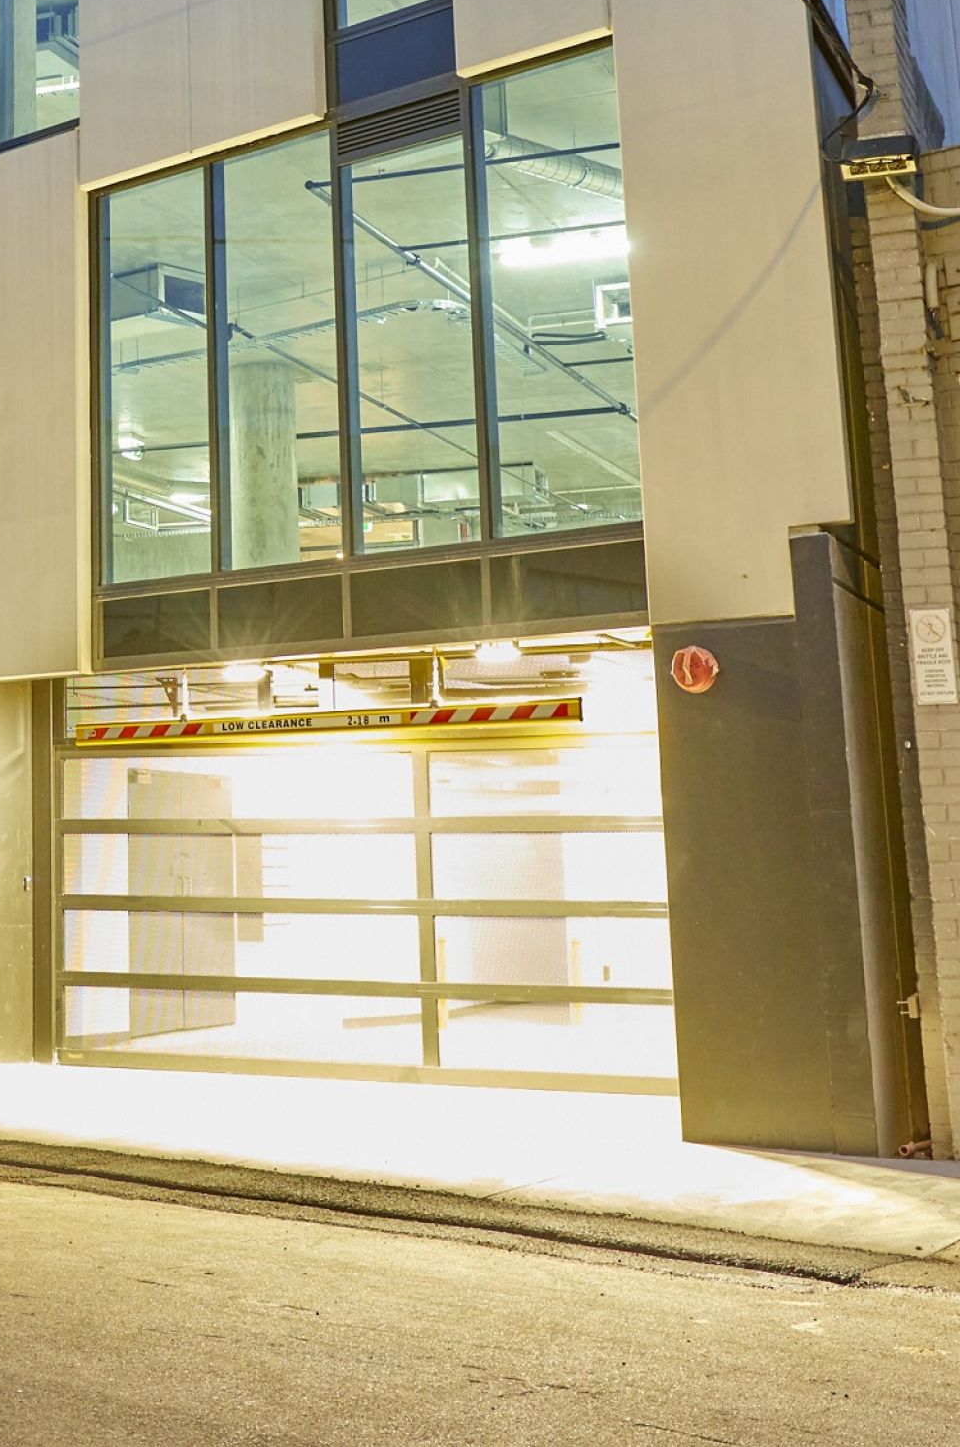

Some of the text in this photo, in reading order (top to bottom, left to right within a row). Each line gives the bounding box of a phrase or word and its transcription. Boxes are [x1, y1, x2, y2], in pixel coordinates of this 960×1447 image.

[222, 715, 390, 731] LOW CLEARANCE 2.18 m
